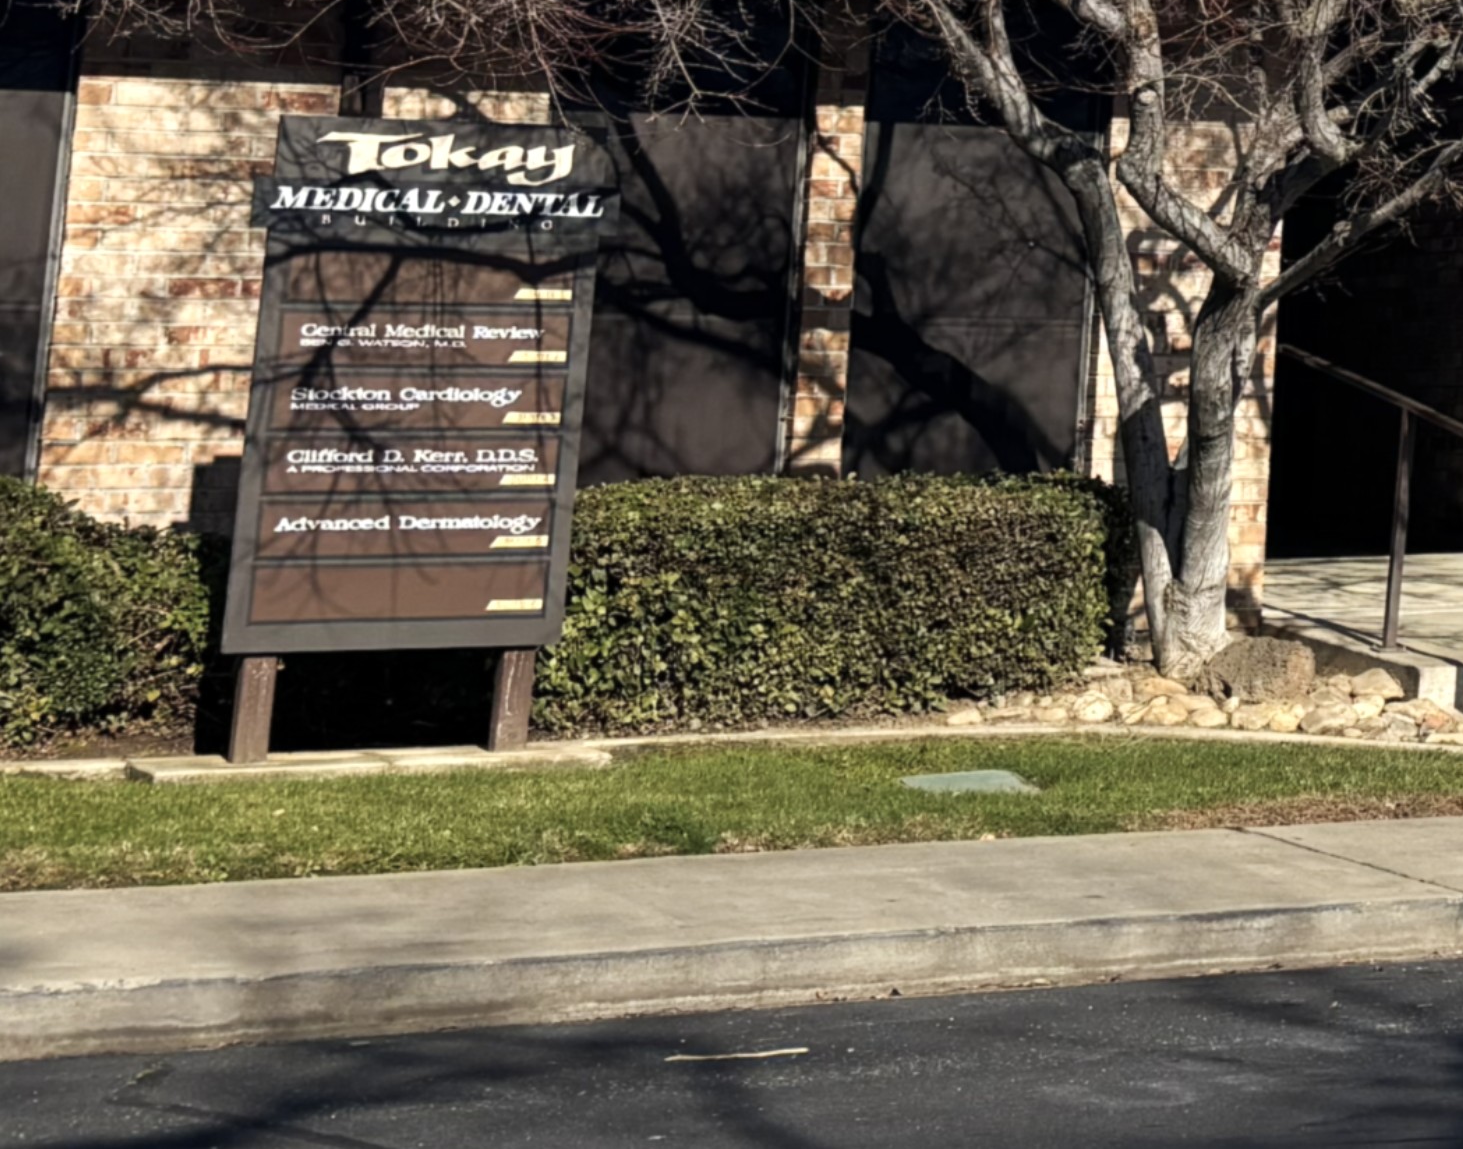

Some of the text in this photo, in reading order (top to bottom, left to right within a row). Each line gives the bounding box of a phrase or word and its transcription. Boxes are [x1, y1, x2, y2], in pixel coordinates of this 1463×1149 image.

[316, 131, 575, 187] Tokay
[271, 185, 604, 218] MEDICAL DENTAL
[301, 323, 544, 340] Central Medical Review
[291, 386, 523, 408] Stockton Cardiology
[290, 402, 421, 411] MEDICAL GROUP
[286, 449, 373, 463] Clifford
[383, 450, 405, 463] D.
[476, 449, 539, 463] D.D.S.
[421, 465, 536, 473] CORPORATION
[274, 514, 542, 534] Advanced Dermatology
